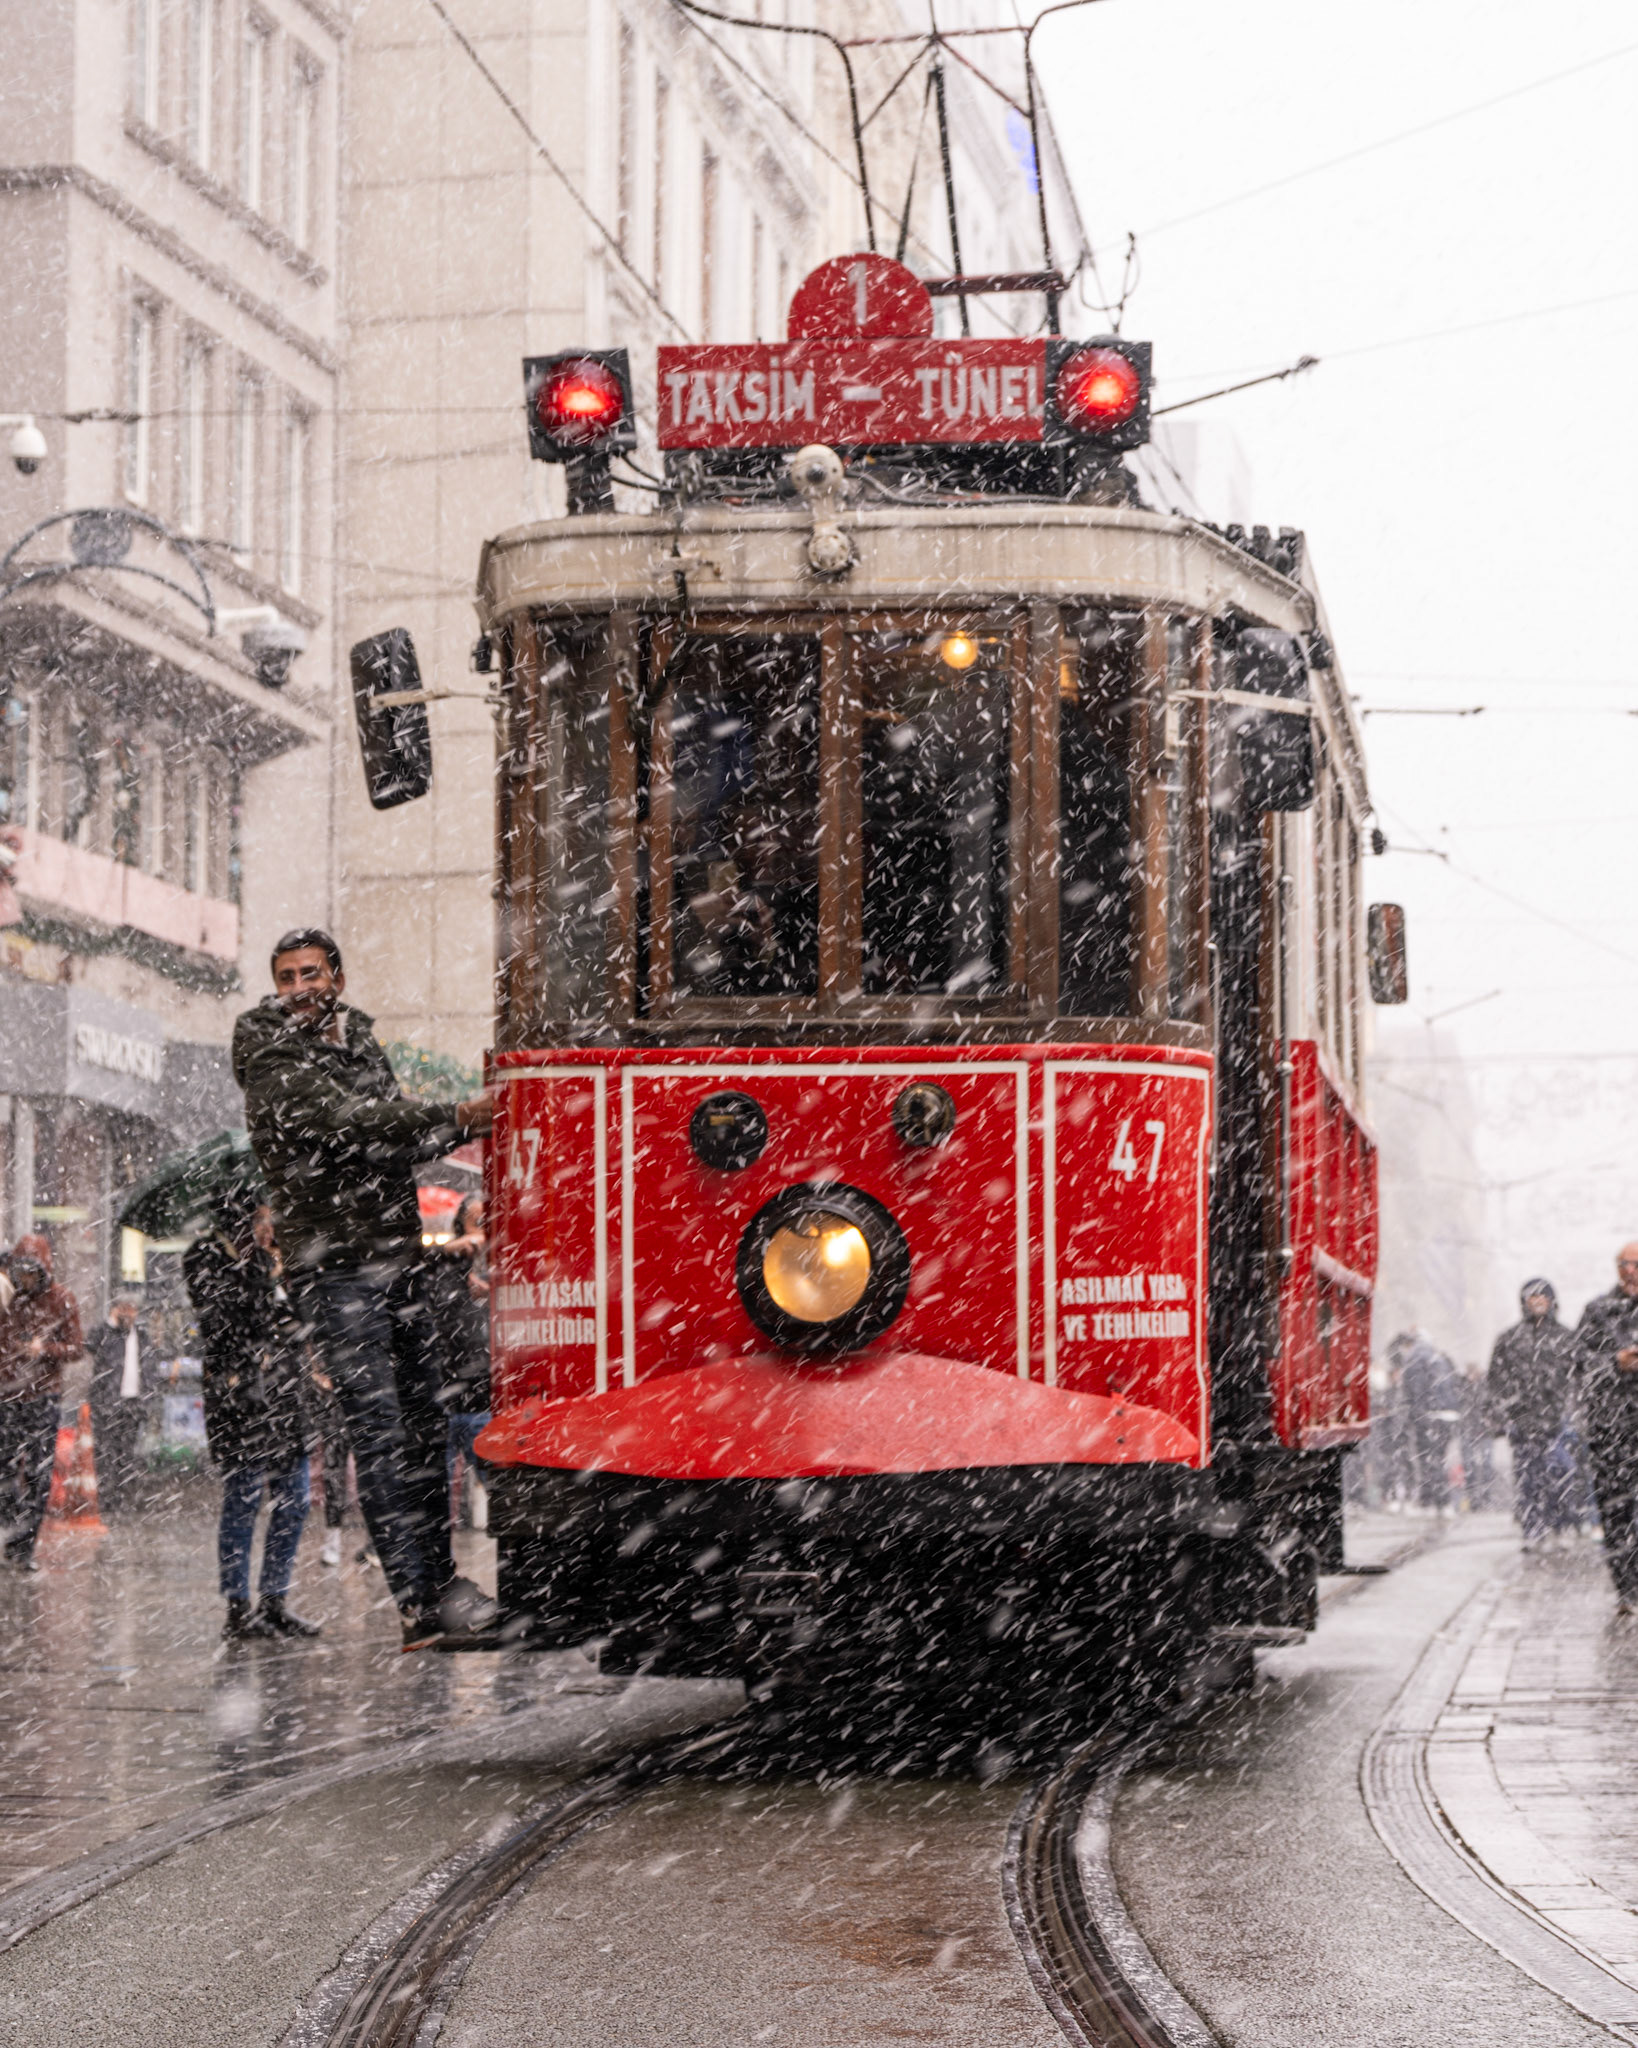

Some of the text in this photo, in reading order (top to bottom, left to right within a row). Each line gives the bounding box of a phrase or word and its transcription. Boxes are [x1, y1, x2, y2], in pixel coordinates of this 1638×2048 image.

[845, 261, 868, 327] 1
[664, 357, 816, 424] TAKSİM
[915, 353, 1045, 421] TÜNEL
[509, 1127, 542, 1190] 47
[1108, 1120, 1166, 1183] 47
[1061, 1272, 1145, 1305] ASILMAK
[1063, 1314, 1087, 1342] VE
